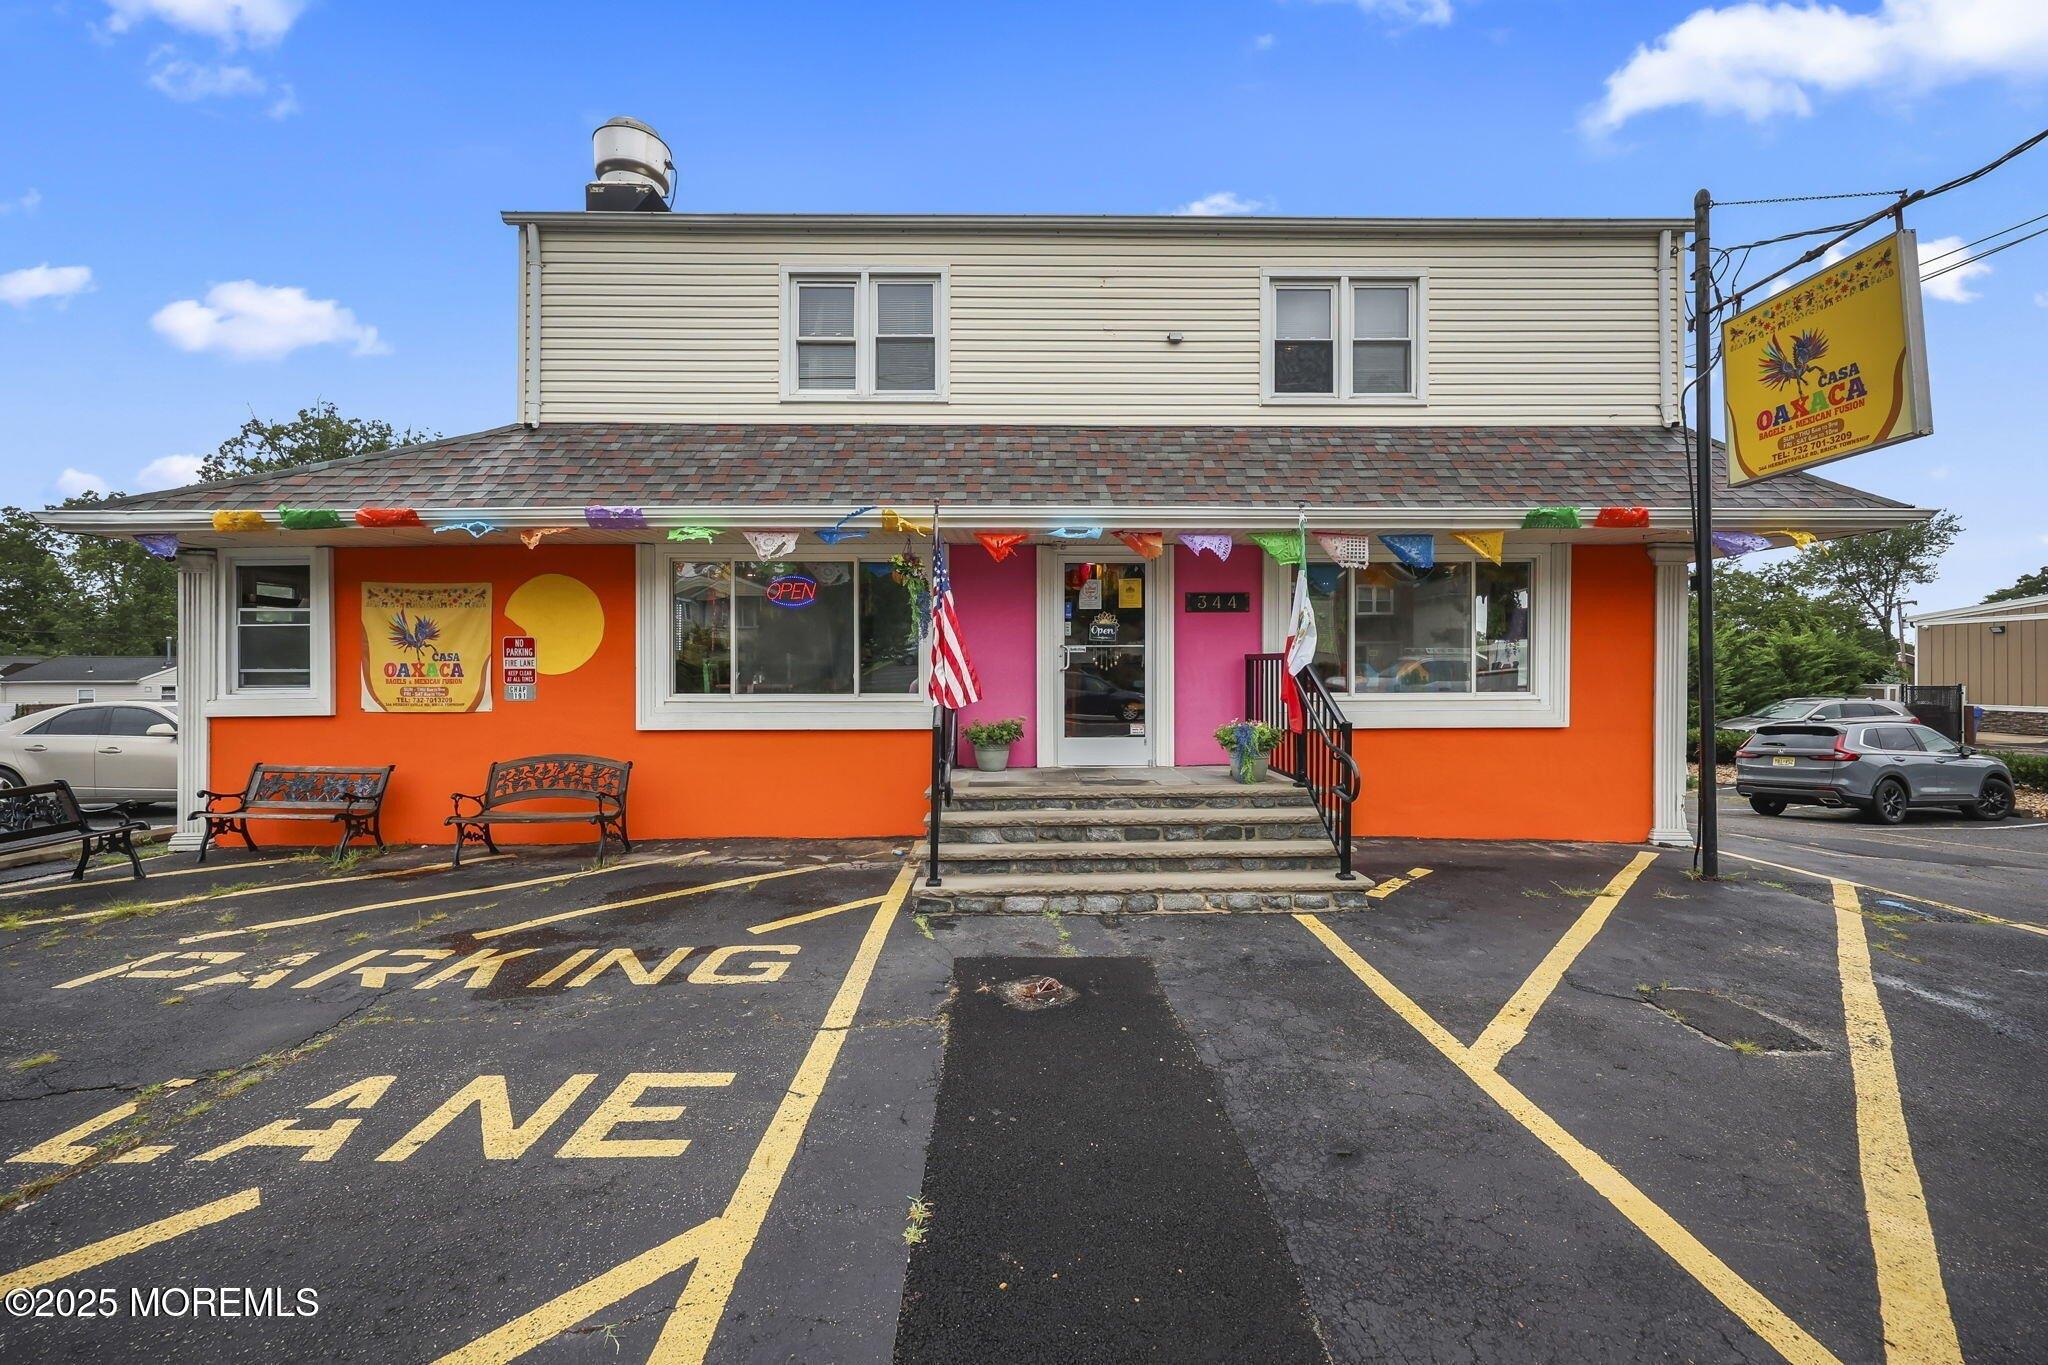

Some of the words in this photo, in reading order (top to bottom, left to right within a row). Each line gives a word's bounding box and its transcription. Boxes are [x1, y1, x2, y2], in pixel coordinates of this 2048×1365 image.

[1818, 362, 1860, 387] CASA
[1757, 376, 1867, 431] OAXACA
[1759, 425, 1786, 440] BAGELS
[1795, 410, 1832, 428] MEXICAN
[1834, 398, 1866, 416] FUSION
[1772, 450, 1790, 461] TEL:
[1792, 445, 1808, 456] 732
[1811, 431, 1852, 450] 701-3209
[1820, 444, 1838, 454] BRICK
[1840, 434, 1870, 448] TOWNSHIP
[766, 582, 817, 600] OPEN
[1091, 625, 1116, 636] Open
[506, 648, 533, 656] PARKING
[514, 639, 524, 648] NO
[432, 653, 460, 661] CASA
[384, 663, 464, 677] OAXACA
[51, 944, 802, 990] PARKING
[4, 1071, 738, 1165] LANE
